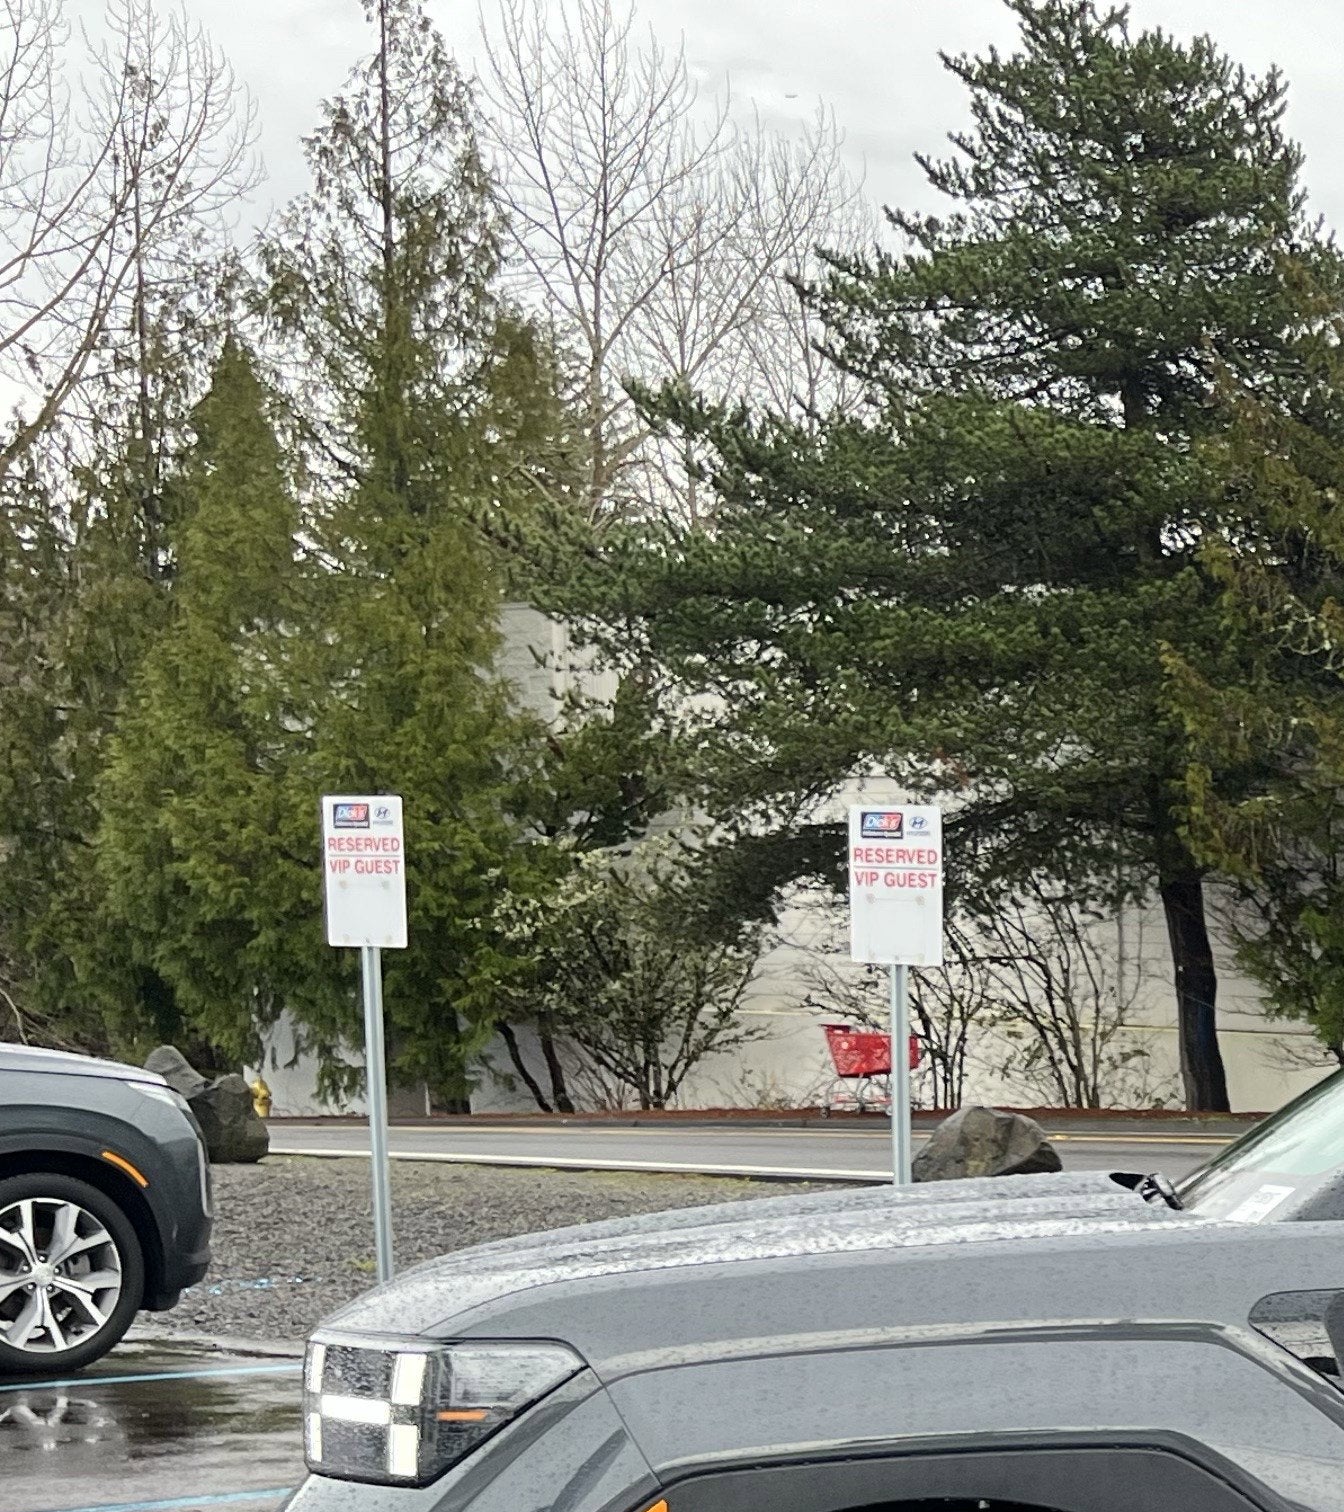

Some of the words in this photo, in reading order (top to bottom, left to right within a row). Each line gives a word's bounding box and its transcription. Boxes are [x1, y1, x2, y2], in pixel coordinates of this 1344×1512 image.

[328, 837, 400, 852] RESERVED
[853, 848, 938, 865] RESERVED
[330, 860, 350, 874] VIP
[355, 860, 400, 874] GUEST
[855, 872, 879, 887] VIP
[884, 872, 937, 888] GUEST
